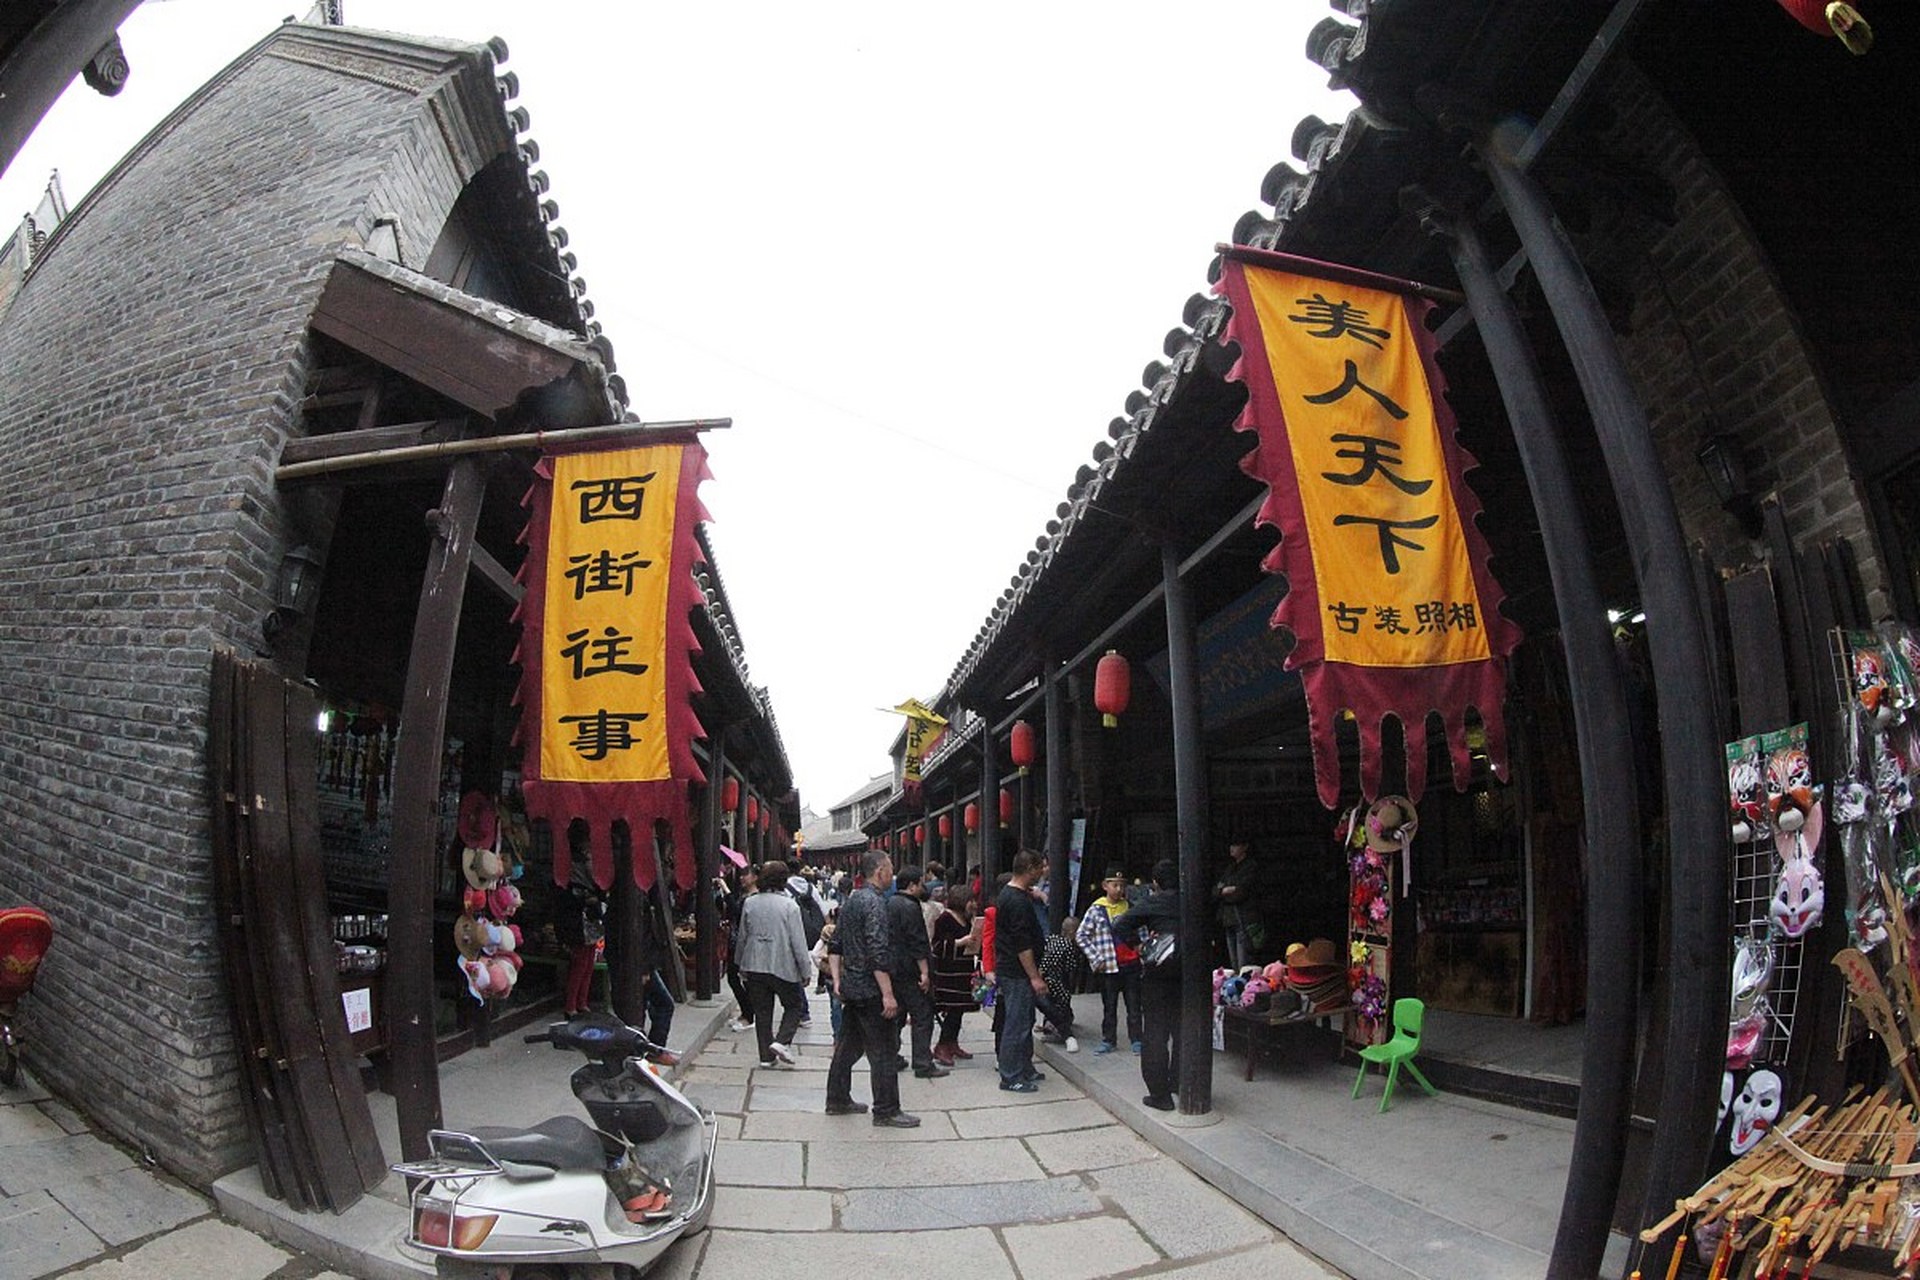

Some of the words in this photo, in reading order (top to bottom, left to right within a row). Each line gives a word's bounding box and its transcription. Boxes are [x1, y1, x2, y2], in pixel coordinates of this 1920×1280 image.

[1288, 294, 1439, 575] 美人天下
[559, 472, 657, 761] 西街往事
[1328, 601, 1477, 635] 古装照相
